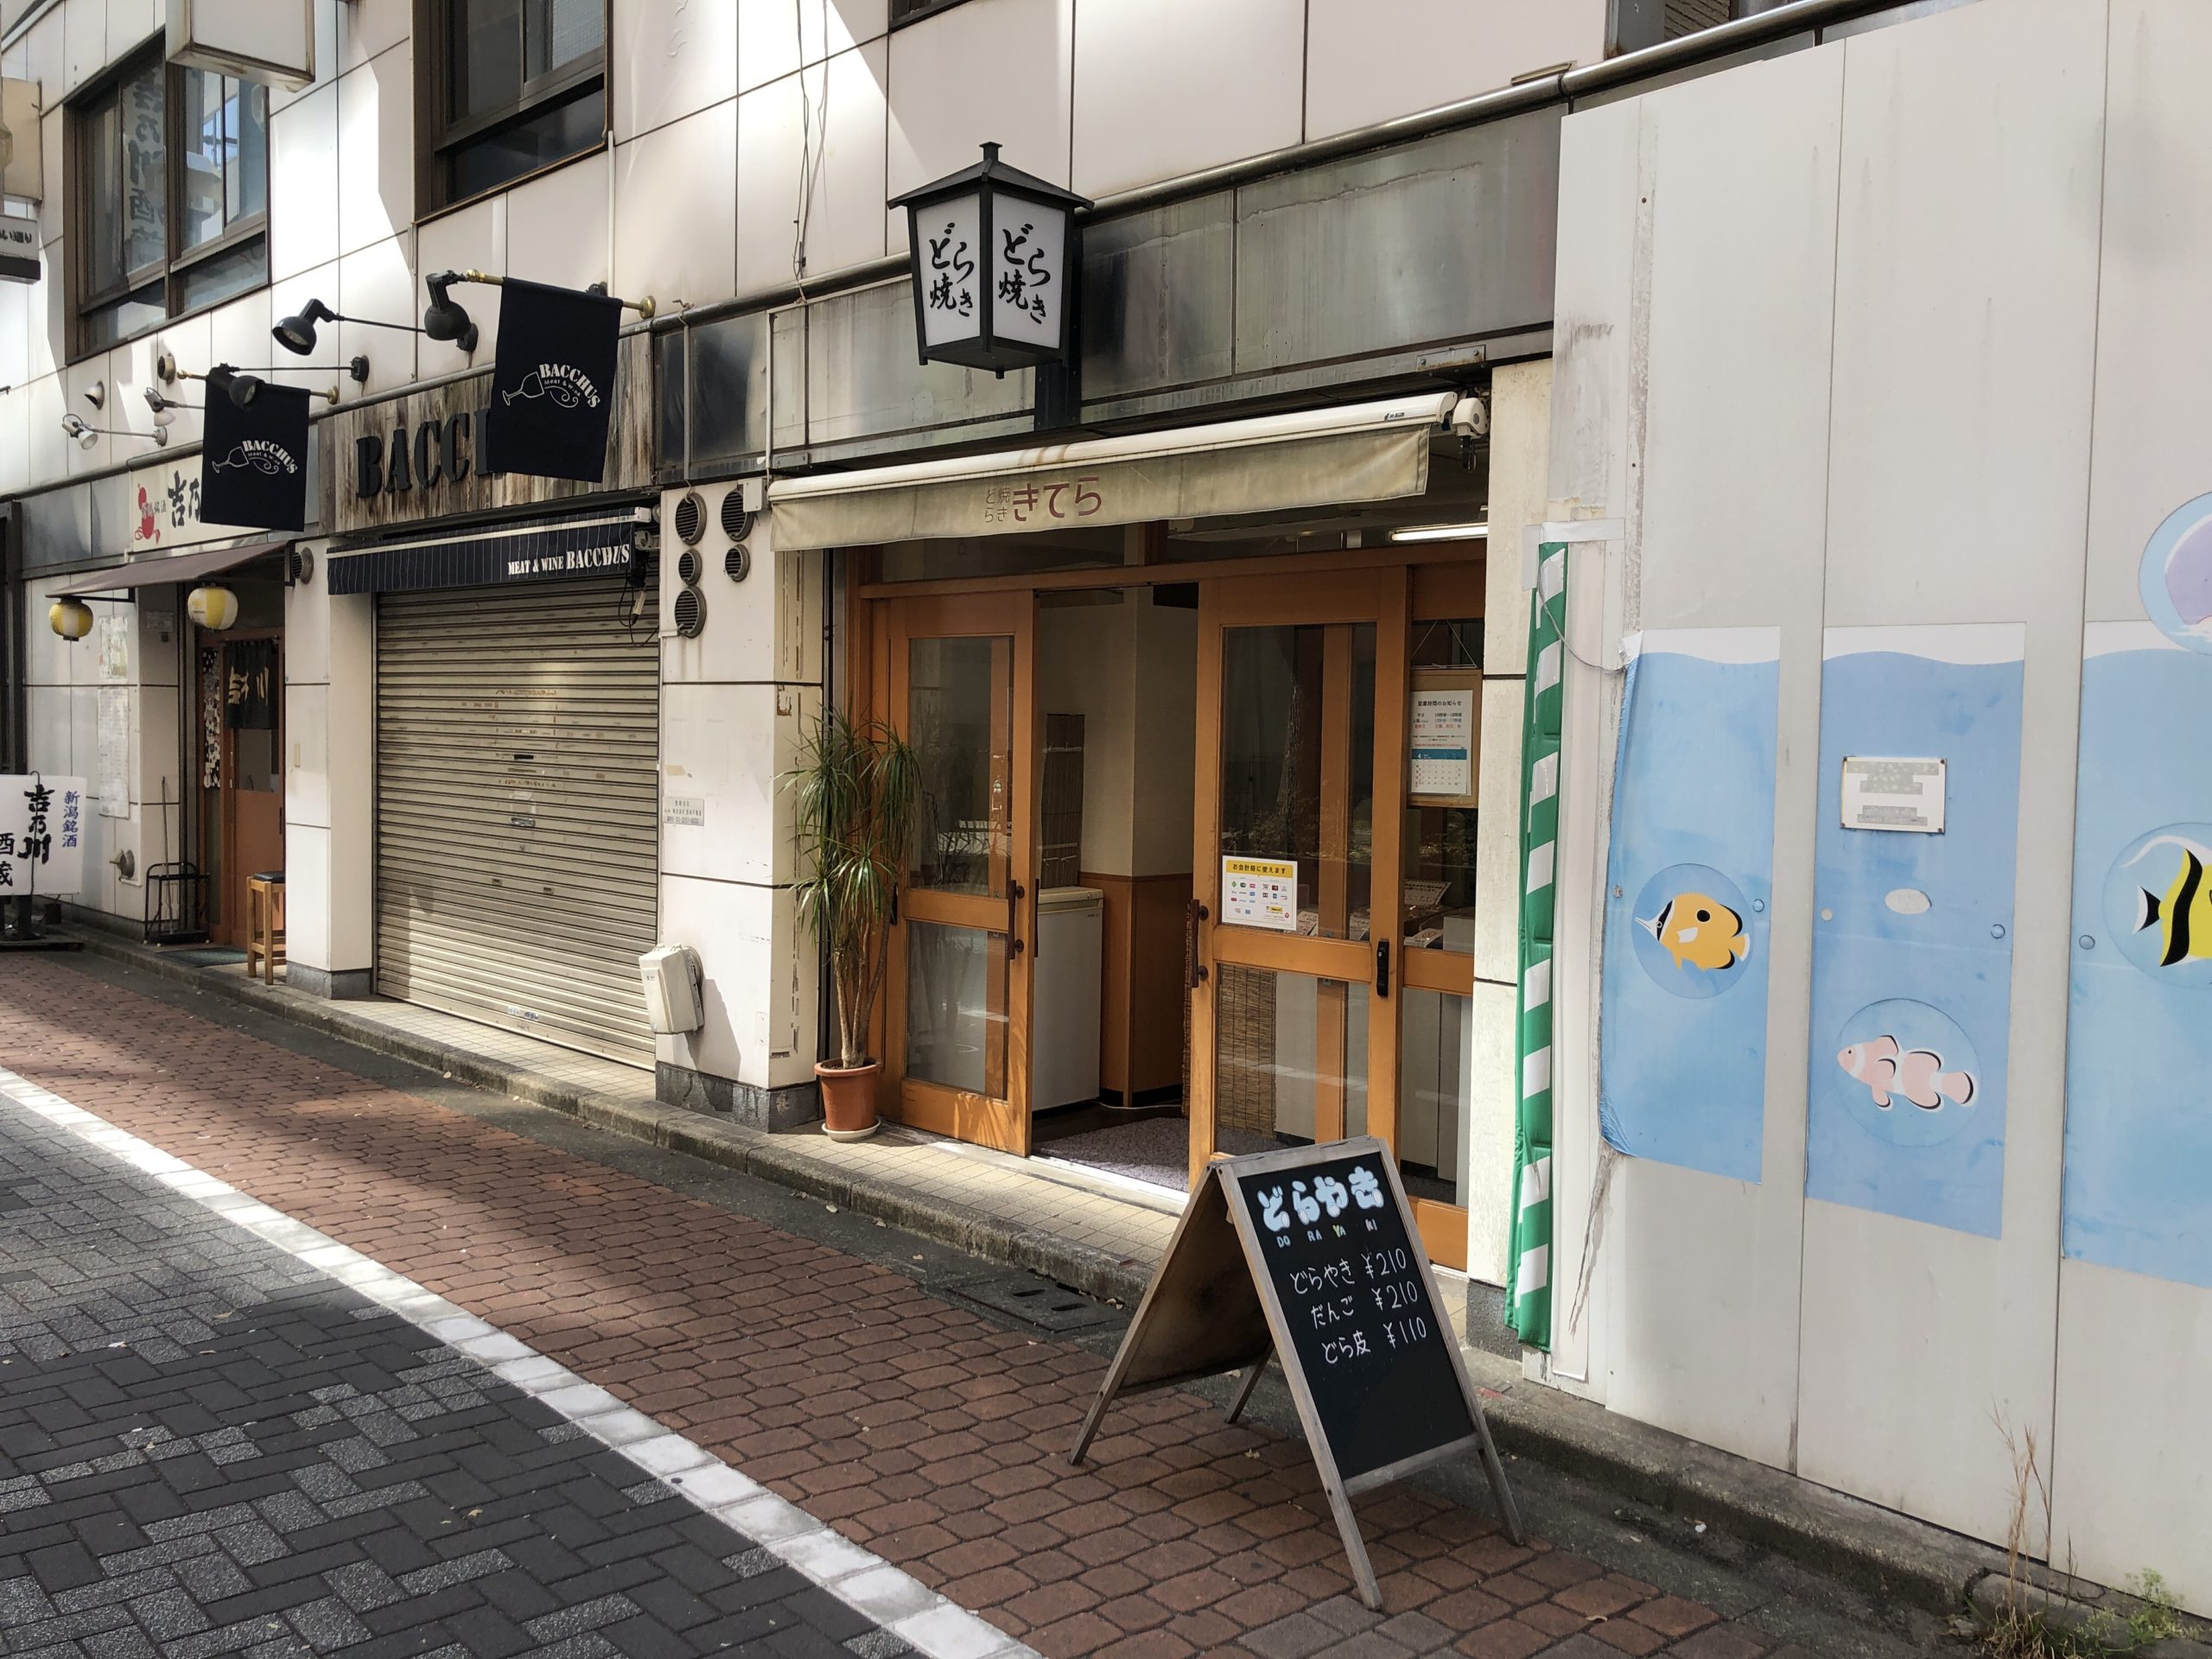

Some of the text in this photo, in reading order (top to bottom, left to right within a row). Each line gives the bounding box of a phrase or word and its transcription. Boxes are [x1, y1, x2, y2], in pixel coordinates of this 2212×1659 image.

[538, 363, 601, 408] BACCHUS
[242, 440, 298, 474] BACCHUS
[1013, 476, 1102, 522] きてら
[508, 543, 630, 575] MEAT & WINE BACCHUS
[17, 784, 55, 865] 吉乃川
[62, 790, 80, 848] 新潟銘酒
[1232, 863, 1287, 874] お会計時に使えます
[1257, 1166, 1384, 1232] どらやき
[1276, 1218, 1378, 1249] DO RA YA KI
[1289, 1248, 1408, 1295] どらやき ¥210
[1311, 1280, 1418, 1330] だんご ¥210
[1321, 1316, 1427, 1363] どら皮 ¥110
